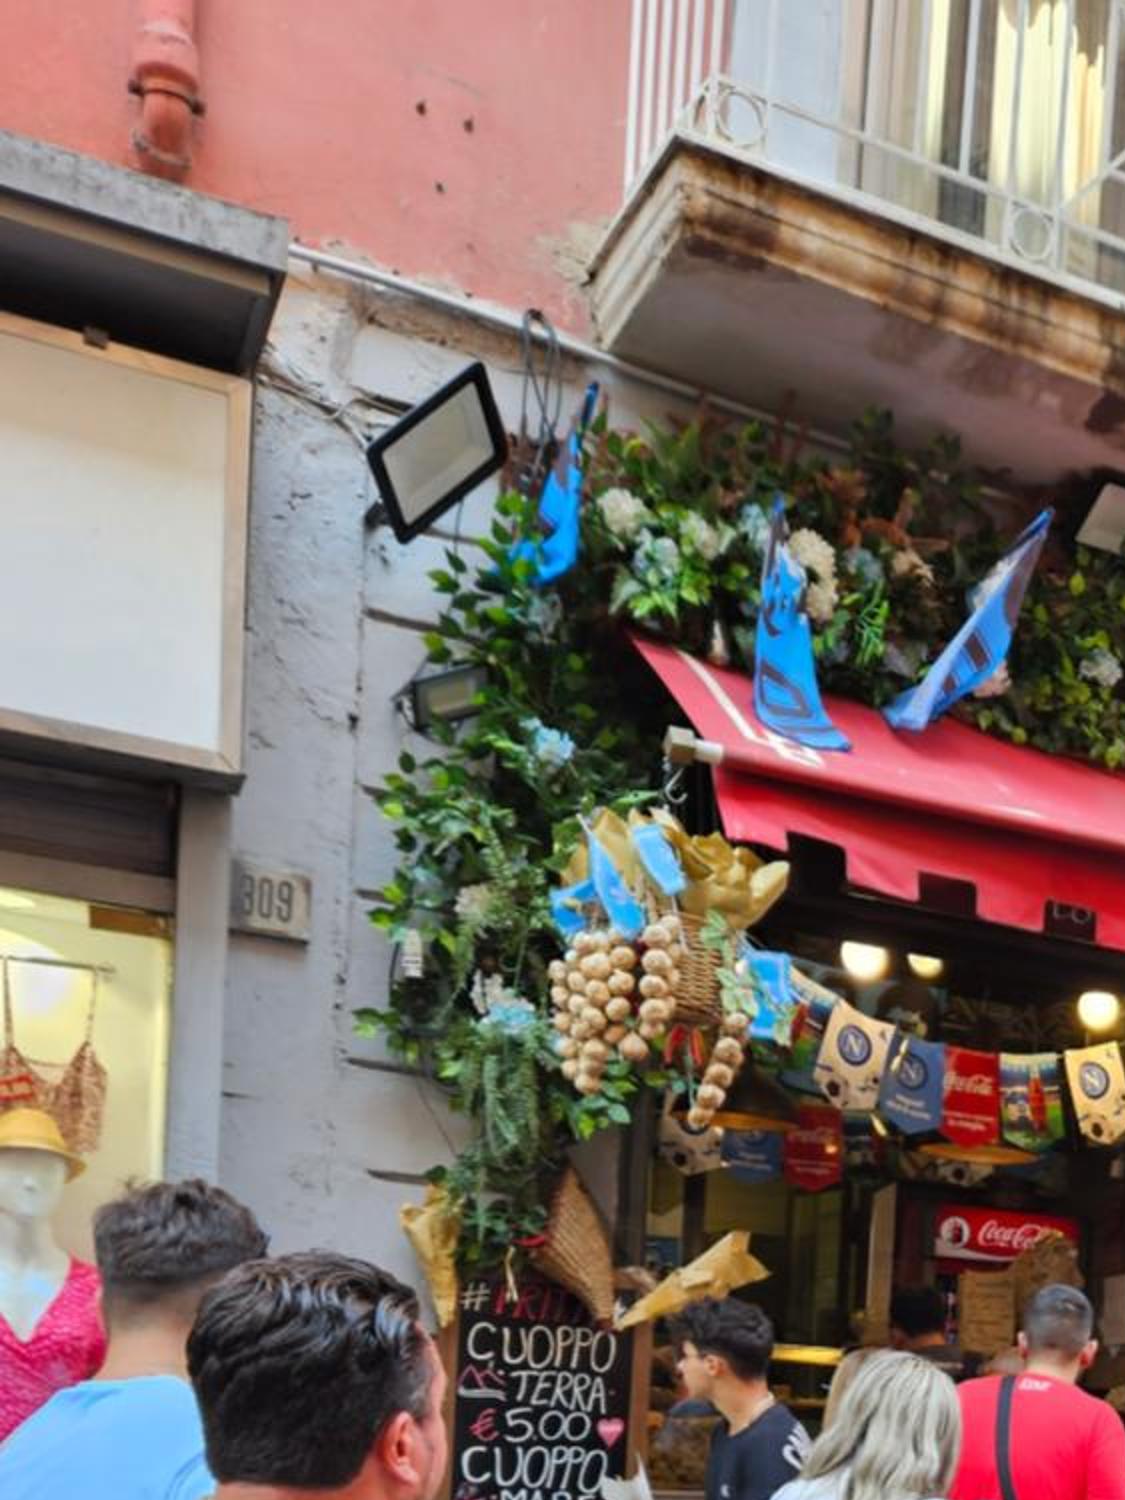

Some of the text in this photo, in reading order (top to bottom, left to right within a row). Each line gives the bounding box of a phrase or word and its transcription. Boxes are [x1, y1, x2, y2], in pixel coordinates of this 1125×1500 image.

[240, 873, 293, 923] 309
[467, 1321, 616, 1373] CUOPPO
[510, 1371, 606, 1414] TERRA
[461, 1446, 608, 1494] CUOPPO
